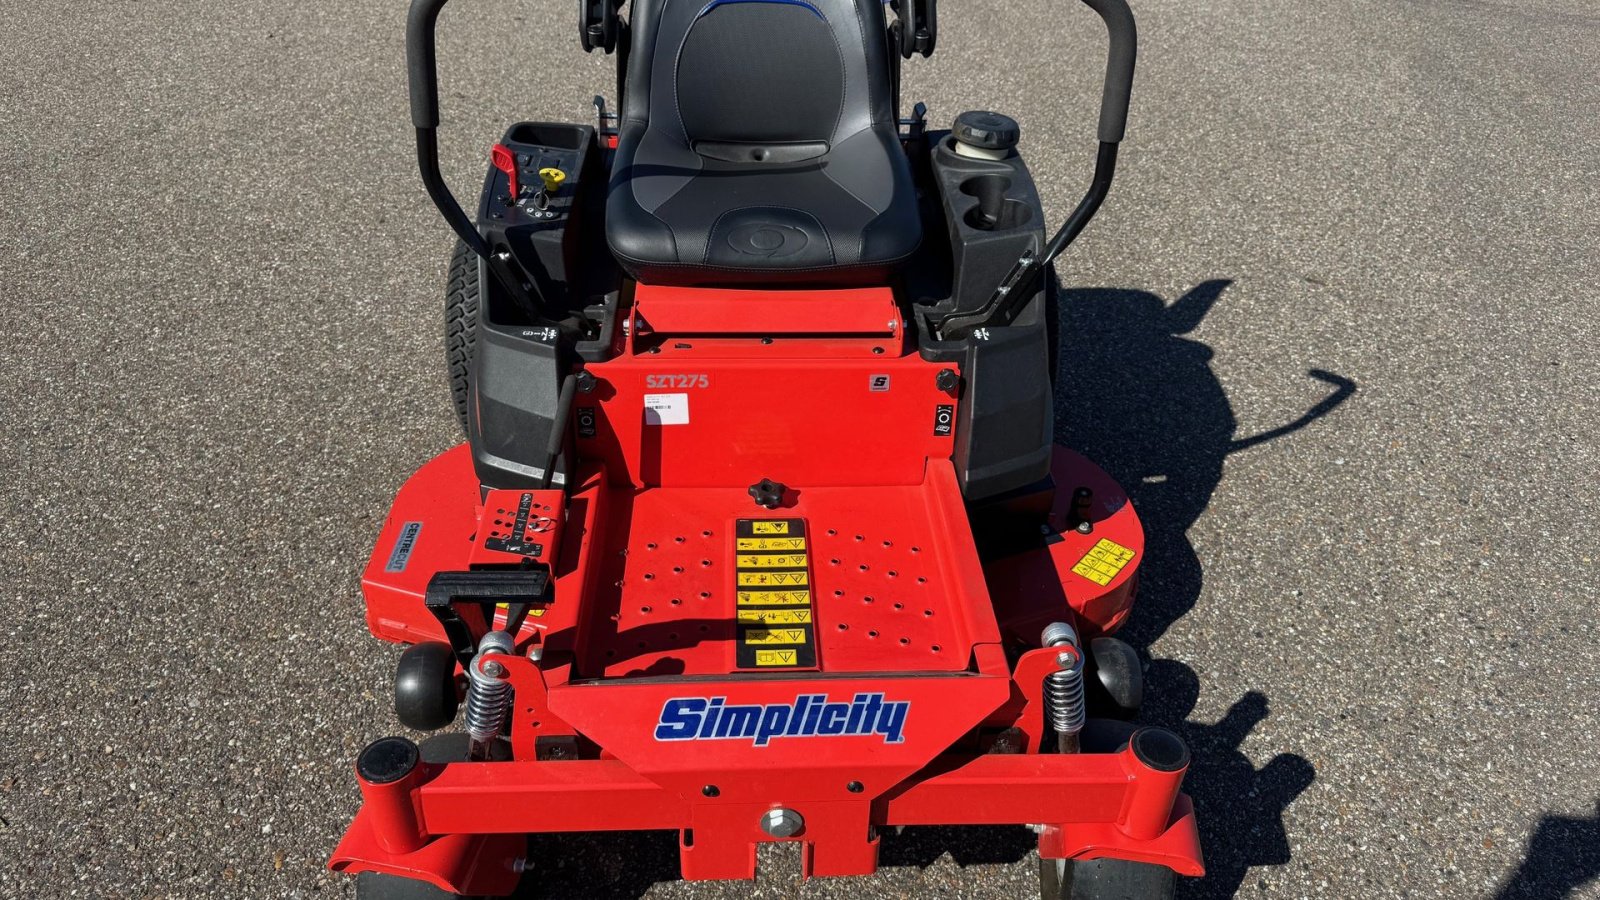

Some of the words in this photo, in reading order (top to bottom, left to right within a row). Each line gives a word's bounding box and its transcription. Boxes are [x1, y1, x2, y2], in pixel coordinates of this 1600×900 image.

[646, 374, 709, 388] SZT275
[392, 523, 420, 570] CENTRECUT
[654, 693, 910, 746] Simplicity
